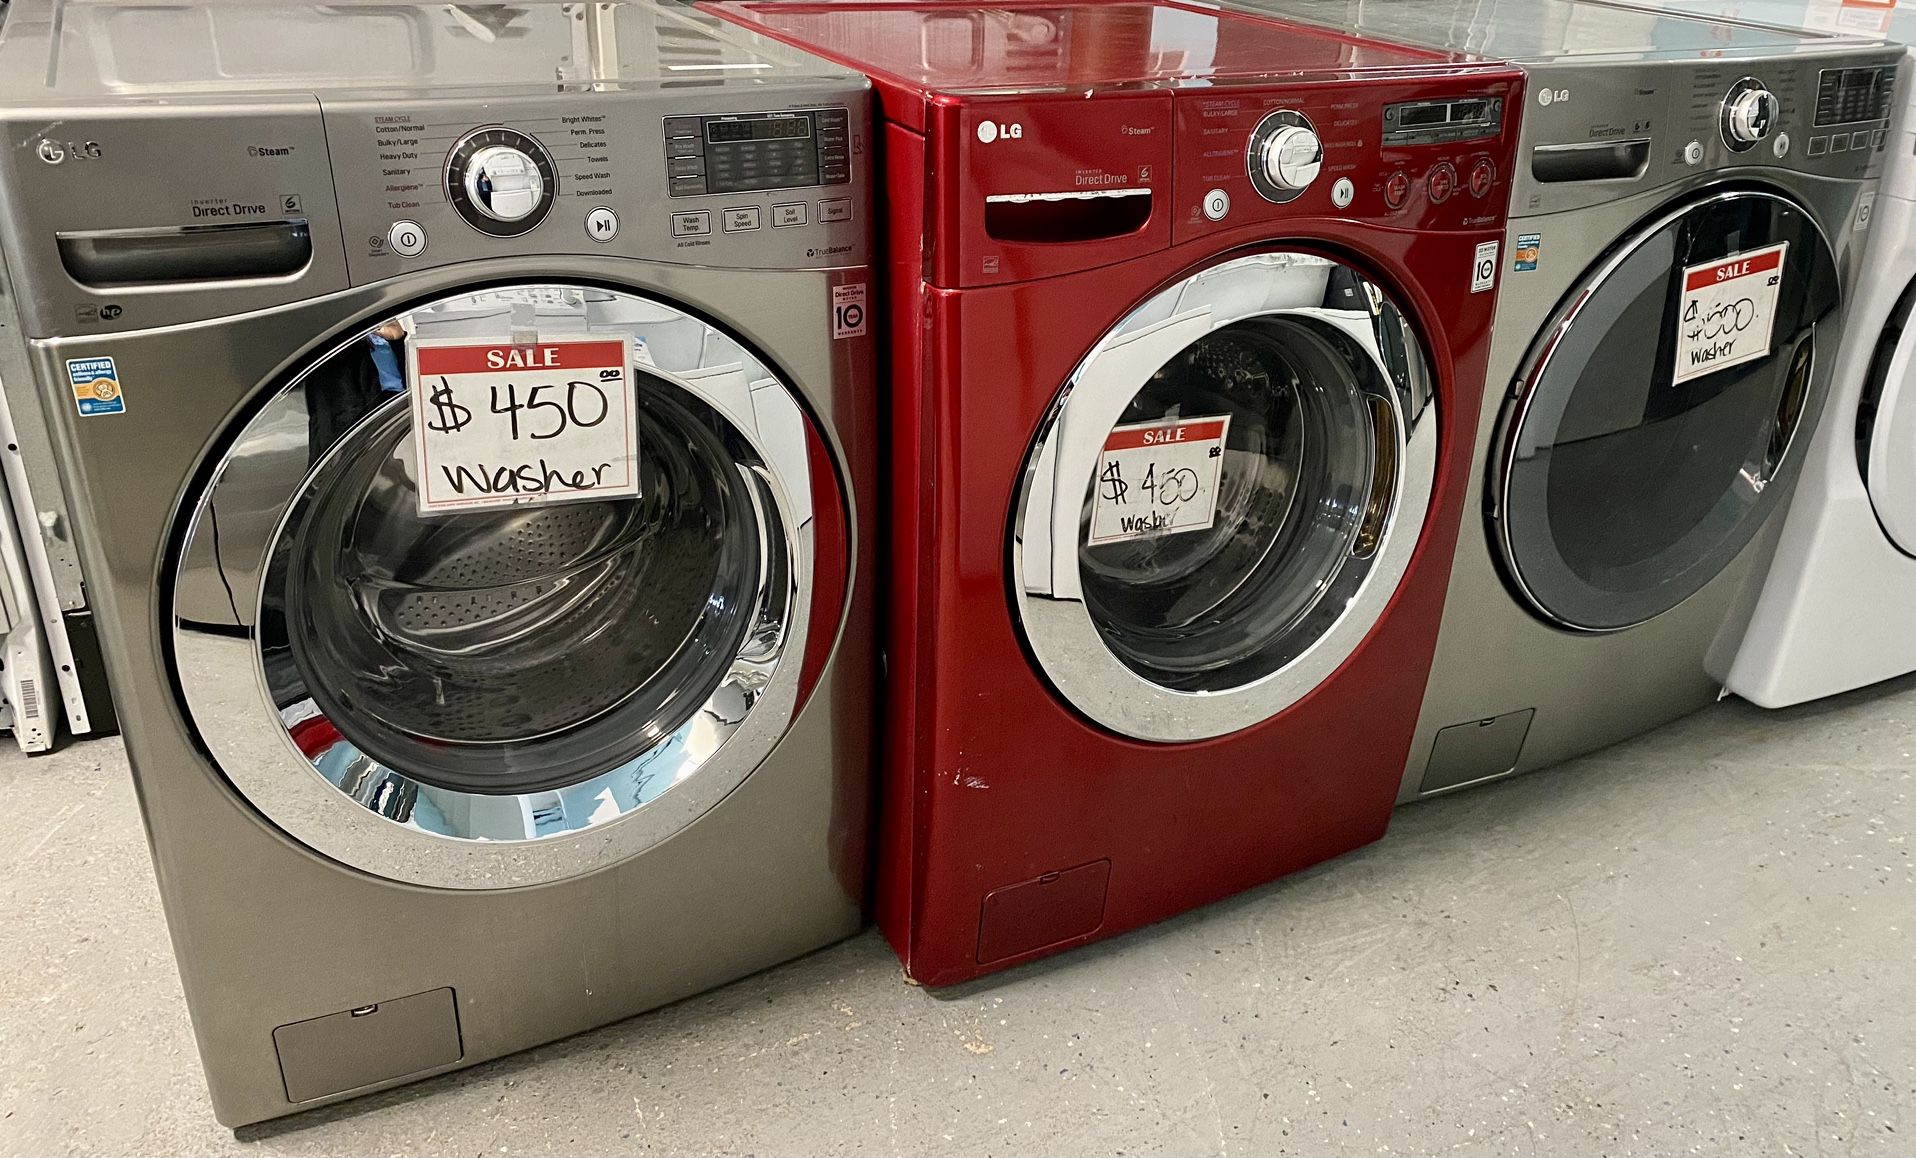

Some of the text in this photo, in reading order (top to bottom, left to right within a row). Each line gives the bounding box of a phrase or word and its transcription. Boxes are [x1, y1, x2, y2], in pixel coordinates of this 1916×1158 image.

[1554, 89, 1570, 102] LG
[375, 124, 425, 133] Cotton/Normal
[1000, 123, 1022, 139] LG
[1589, 127, 1626, 138] Direct Drive
[377, 138, 418, 147] Bulky/Large
[68, 141, 102, 160] LG
[380, 152, 418, 161] Heavy Duty
[587, 155, 609, 163] Towels
[382, 168, 411, 176] Sanitary
[593, 172, 611, 180] Wash
[1075, 173, 1128, 186] Direct Drive
[576, 188, 613, 196] Downloaded
[192, 204, 266, 217] Direct Drive
[828, 207, 843, 215] Signal
[734, 220, 752, 228] Speed
[1476, 259, 1493, 282] 10
[1716, 260, 1751, 282] SALE
[836, 303, 864, 330] 10
[487, 348, 561, 369] SALE
[70, 361, 111, 371] CERTIFIED
[428, 375, 472, 434] $
[490, 380, 608, 440] 450
[1143, 427, 1186, 444] SALE
[1101, 460, 1129, 505] $
[1142, 463, 1199, 505] 450
